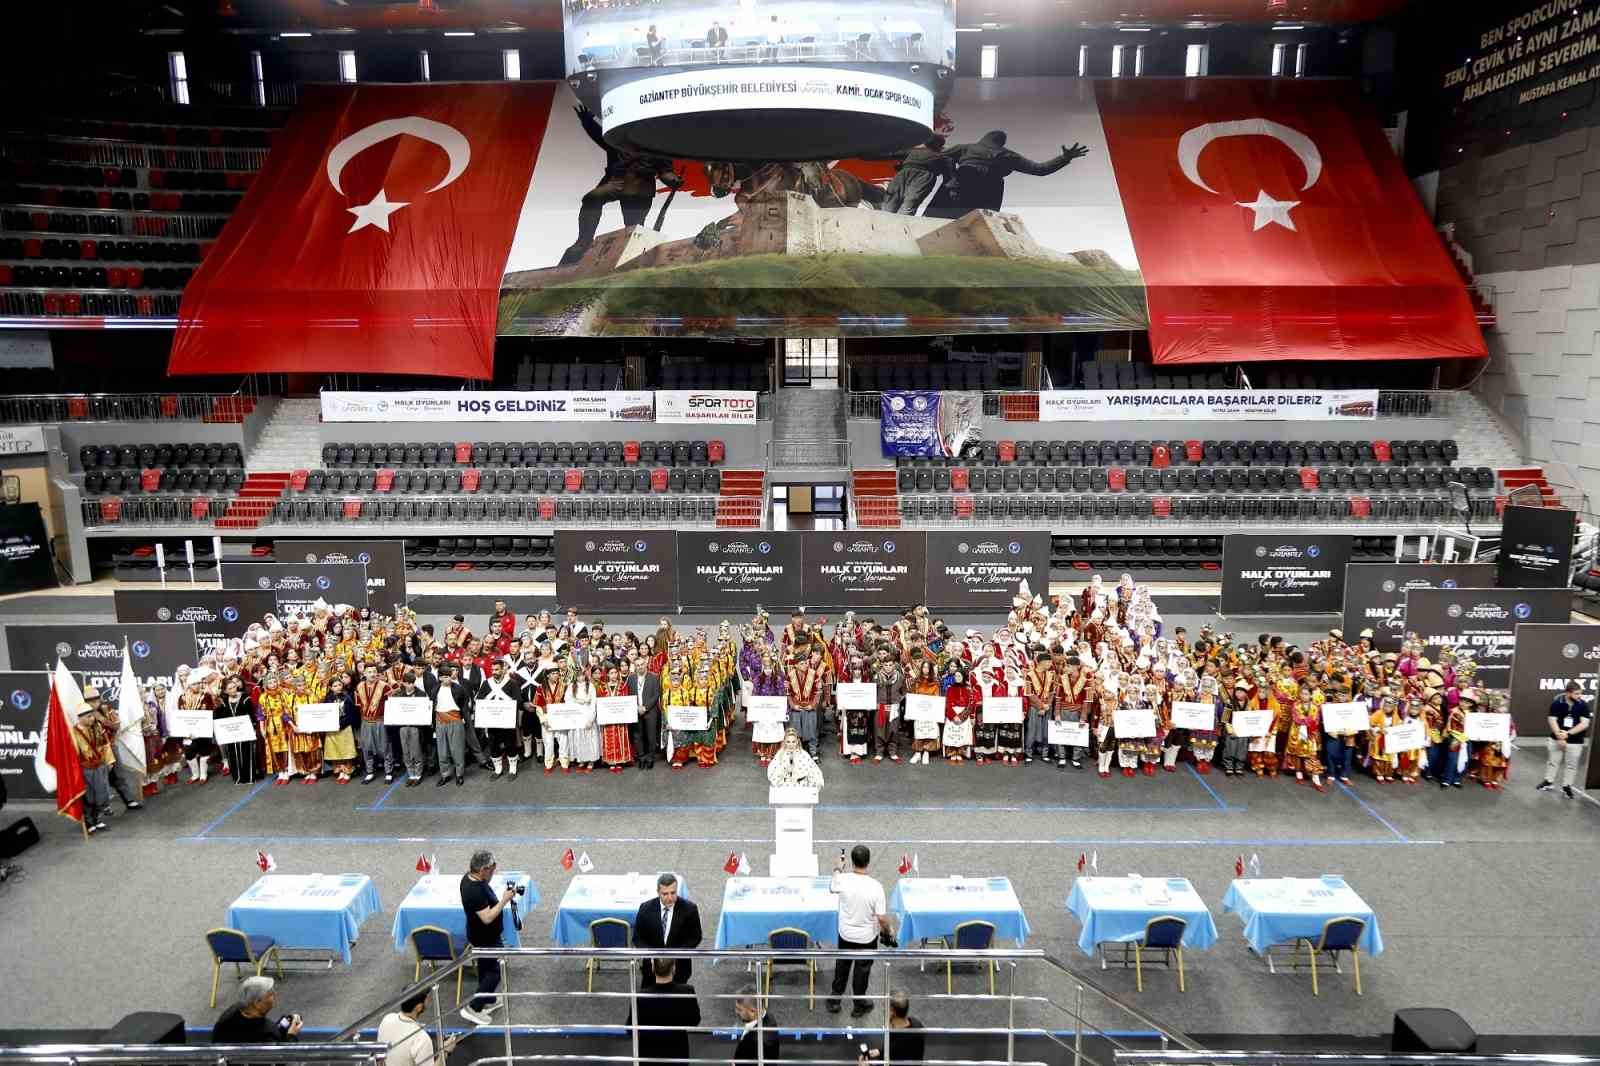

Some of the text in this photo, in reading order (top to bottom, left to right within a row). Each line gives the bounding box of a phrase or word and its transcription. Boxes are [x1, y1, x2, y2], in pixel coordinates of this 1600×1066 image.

[1480, 26, 1504, 49] BEN
[1508, 42, 1523, 60] VE
[1526, 25, 1558, 54] AYNI
[640, 88, 680, 104] GAZİANTEP
[681, 81, 738, 97] BÜYÜKŞEHİR
[741, 80, 797, 93] BELEDİYESİ
[1107, 395, 1323, 407] YARIŞMACILARA BAŞARILAR DİLERİZ
[458, 400, 566, 414] HOŞ GELDİNİZ
[574, 564, 660, 573] HALK OYUNLARI
[697, 565, 783, 574] HALK OYUNLARI
[821, 565, 908, 573] HALK OYUNLARI
[945, 566, 1033, 574] HALK OYUNLARI
[1241, 570, 1331, 578] HALK OYUNLARI
[1365, 608, 1402, 617] HALK
[1428, 635, 1516, 646] HALK OYUN
